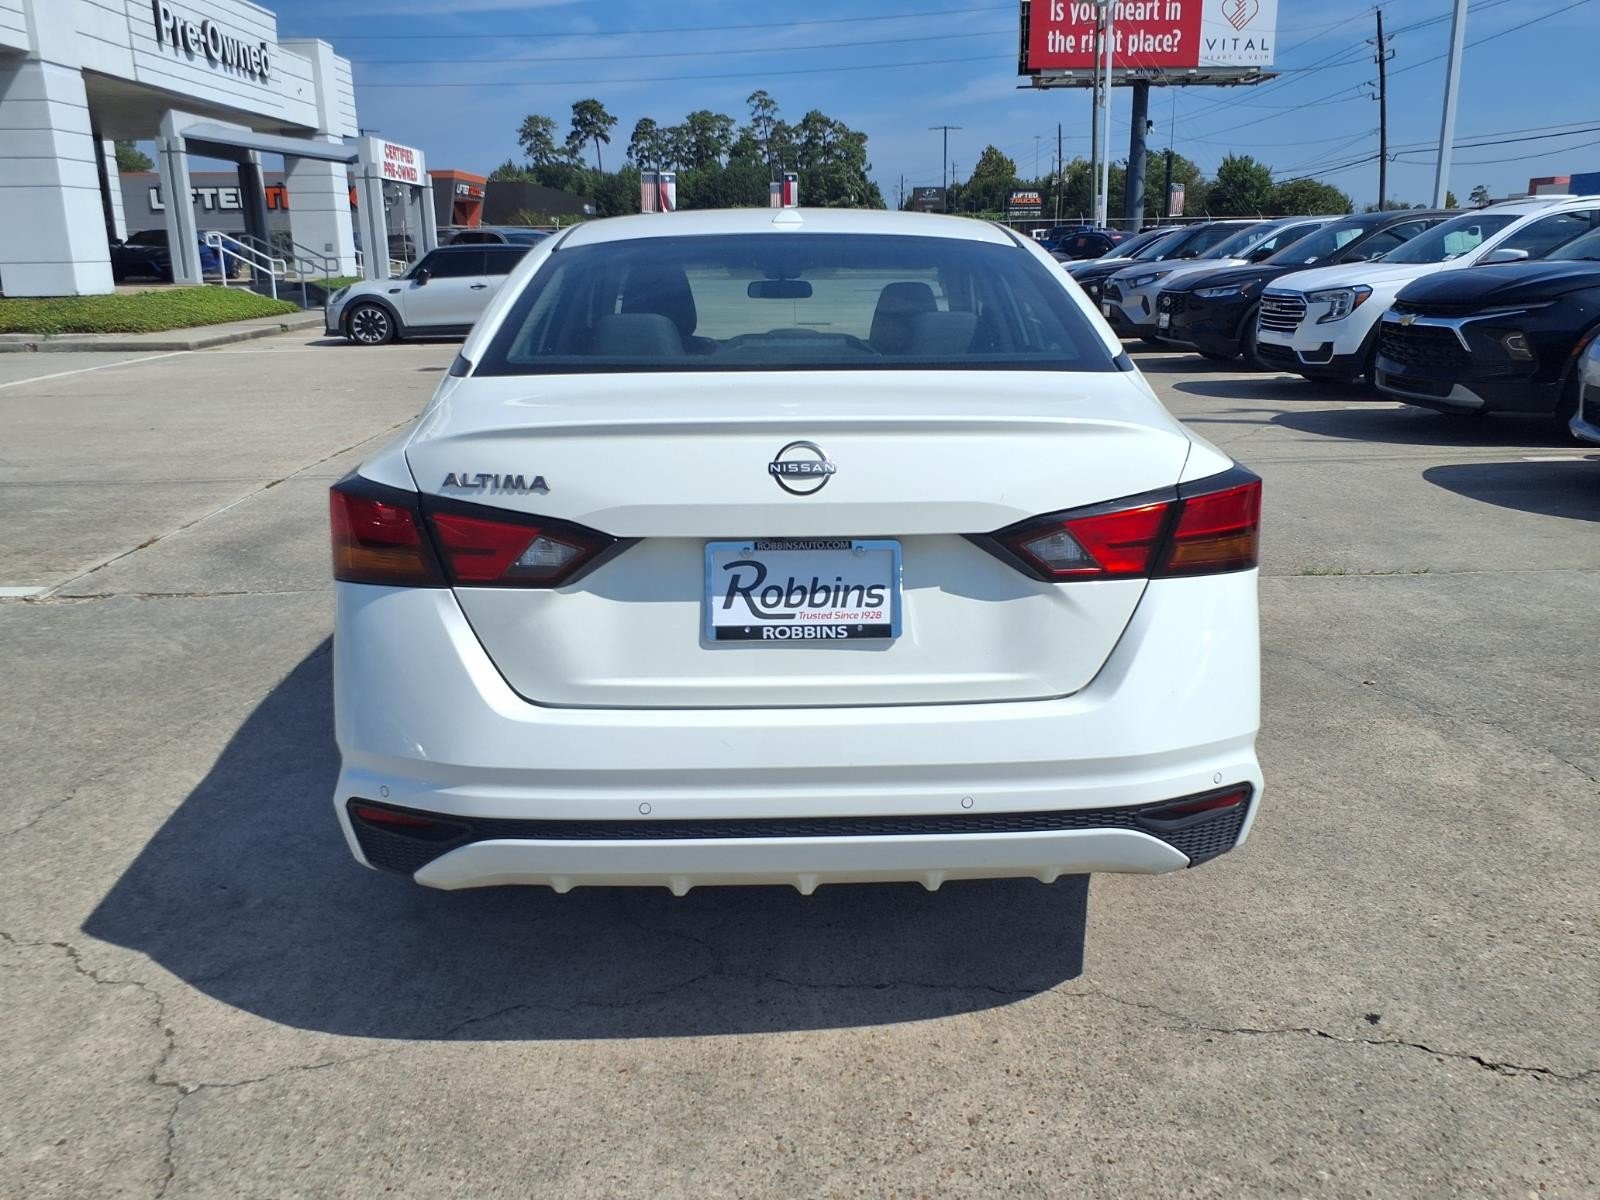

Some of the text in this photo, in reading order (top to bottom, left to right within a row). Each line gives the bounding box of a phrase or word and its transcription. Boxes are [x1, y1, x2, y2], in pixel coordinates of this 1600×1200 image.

[1050, 0, 1064, 21] Is
[1165, 0, 1181, 20] in
[152, 0, 271, 79] Pre-Owned
[1048, 30, 1075, 53] the
[1128, 29, 1182, 56] place?
[1206, 38, 1269, 51] VITAL
[384, 143, 414, 165] CERTIFIED
[384, 161, 418, 182] PRE-OWNED
[149, 187, 243, 209] LTE
[770, 463, 835, 473] NISSAN
[442, 473, 551, 490] ALTIMA
[756, 541, 850, 551] ROBBINSAUTO.COM
[722, 559, 886, 620] Robbins
[799, 610, 882, 620] Trusted Since 1928
[763, 626, 848, 640] ROBBINS
